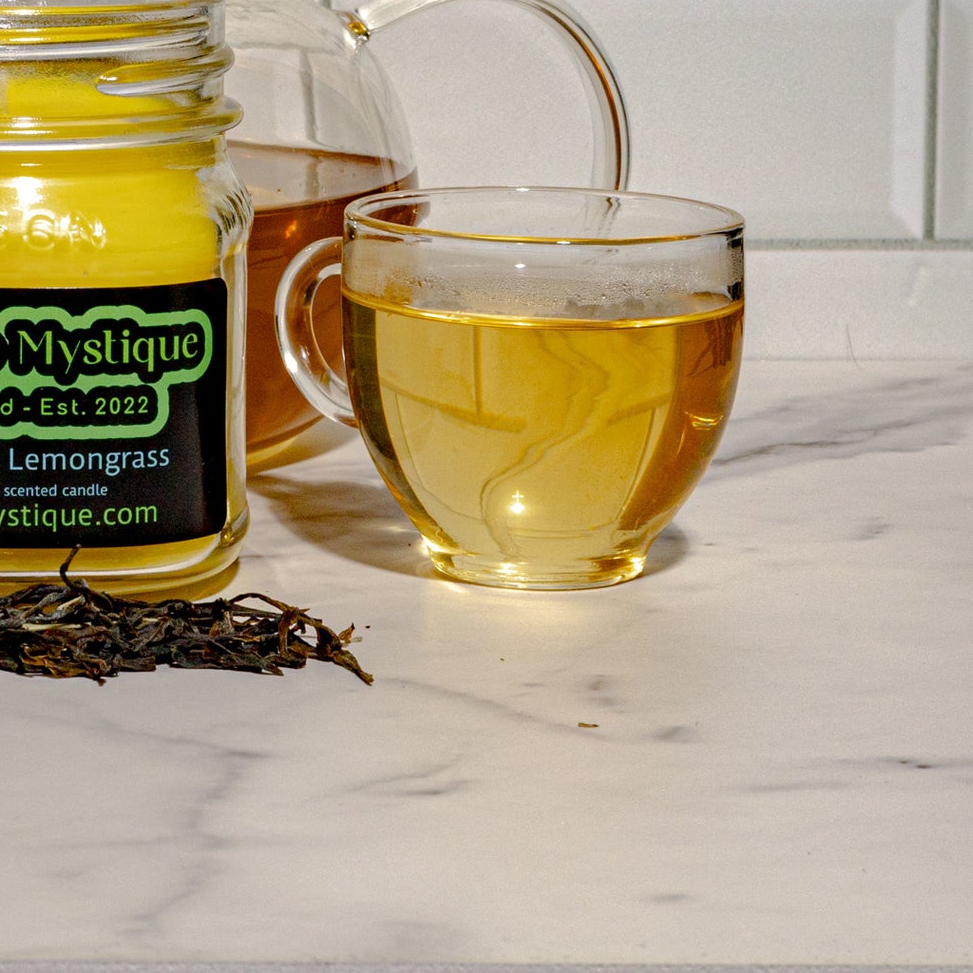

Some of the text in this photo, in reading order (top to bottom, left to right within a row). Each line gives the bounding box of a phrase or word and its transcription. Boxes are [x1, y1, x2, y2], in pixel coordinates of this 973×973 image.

[17, 329, 199, 374] Mystique
[40, 398, 86, 416] Est.
[95, 396, 149, 415] 2022
[9, 447, 170, 476] Lemongrass
[3, 484, 57, 497] scented
[62, 483, 108, 496] candle
